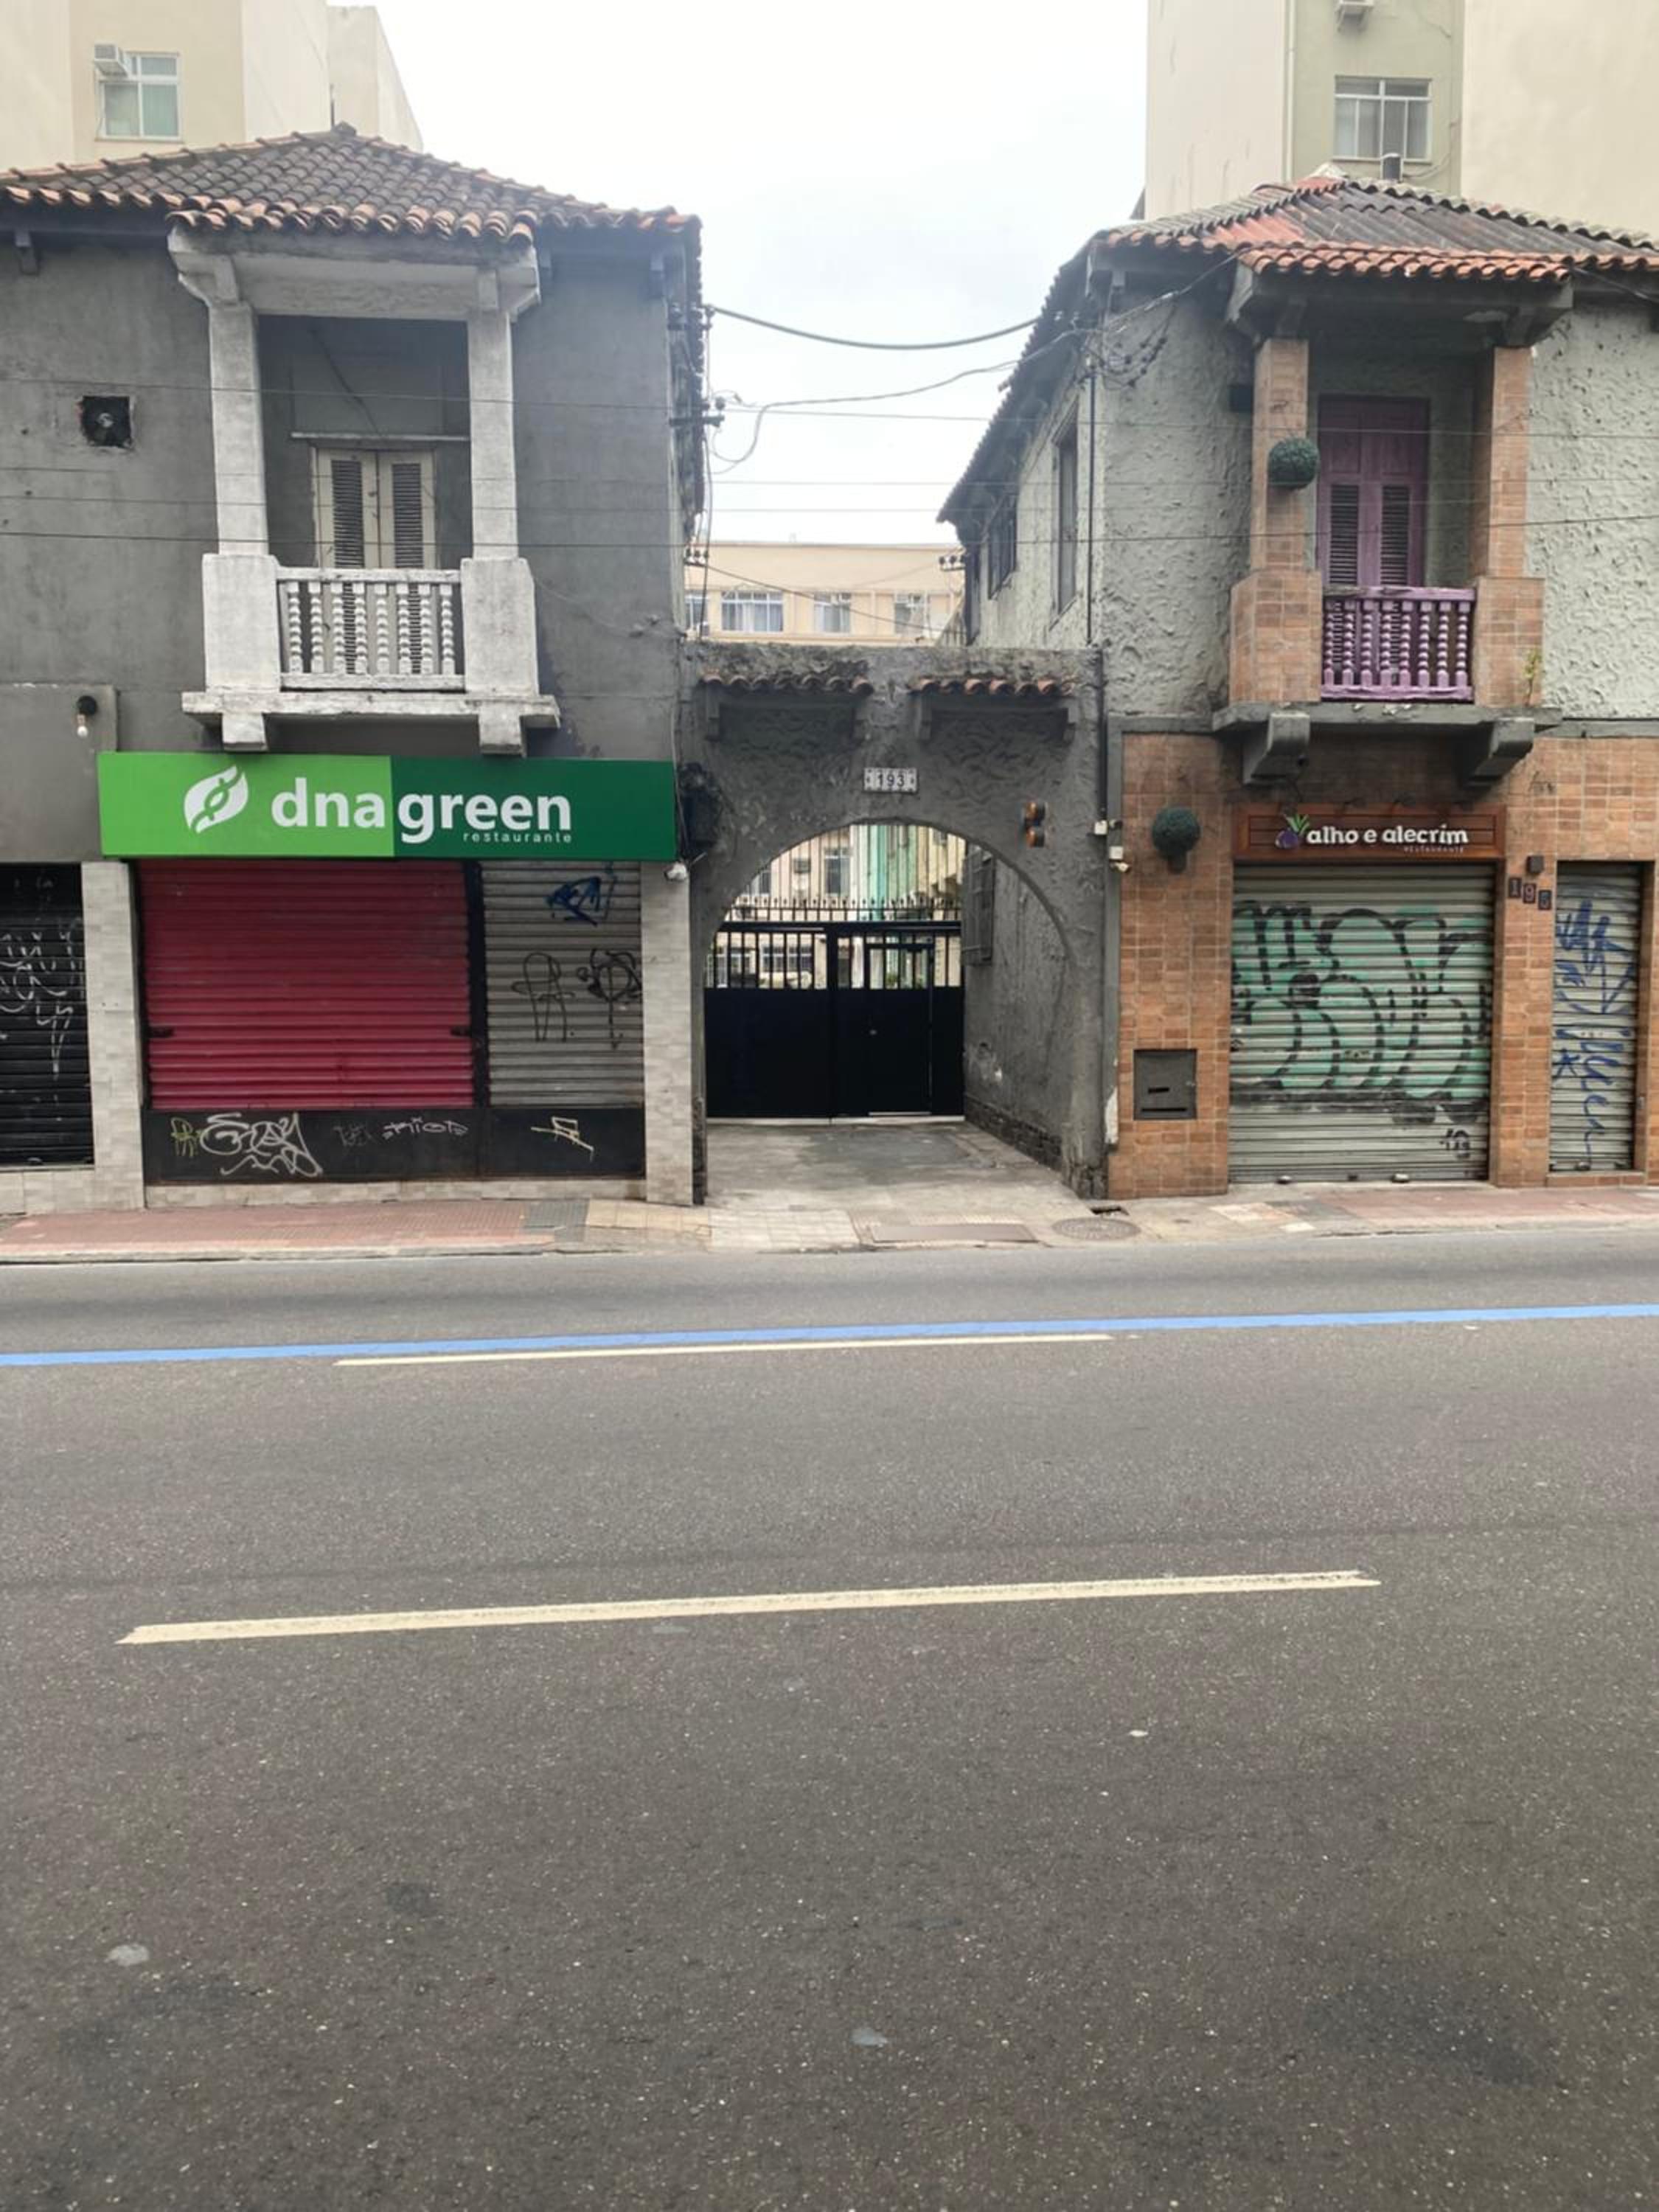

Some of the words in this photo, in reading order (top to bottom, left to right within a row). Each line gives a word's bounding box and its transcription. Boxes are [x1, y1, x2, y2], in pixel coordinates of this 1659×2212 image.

[877, 773, 905, 787] 193
[463, 831, 572, 843] restaurante
[1306, 826, 1359, 844] alho
[1363, 829, 1377, 843] e
[1381, 824, 1469, 844] alecrim
